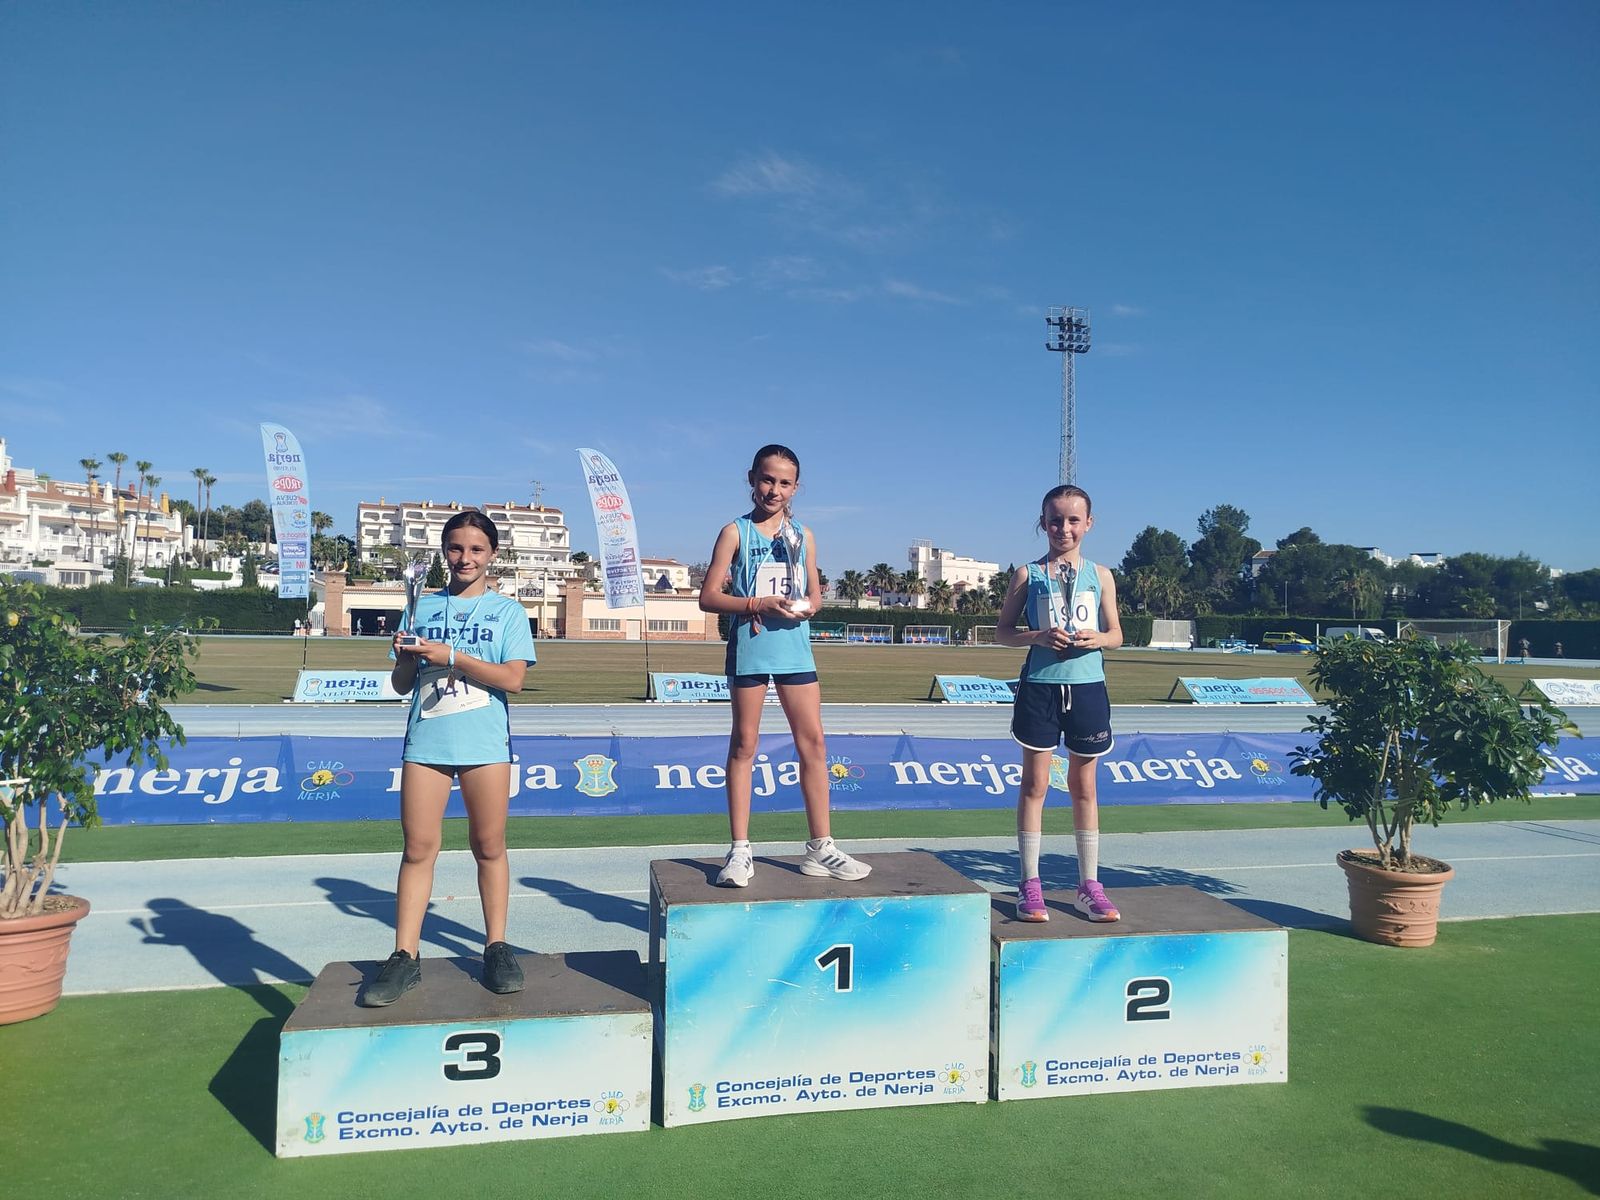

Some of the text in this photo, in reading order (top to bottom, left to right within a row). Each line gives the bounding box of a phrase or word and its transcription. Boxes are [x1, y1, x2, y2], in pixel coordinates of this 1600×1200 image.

[428, 623, 494, 644] nerja
[324, 677, 379, 690] nerja
[681, 680, 730, 692] nerja
[959, 682, 1006, 694] nerja
[1202, 683, 1245, 695] nerja
[306, 760, 345, 771] CMD
[653, 754, 801, 797] neja
[1104, 750, 1243, 788] nerja
[93, 757, 283, 805] nerja
[297, 790, 341, 801] NERJA
[817, 945, 851, 991] 1
[1125, 978, 1171, 1022] 2
[443, 1031, 502, 1081] 3
[1045, 1051, 1241, 1071] Concejalía de Deportes
[715, 1068, 936, 1094] Concejalía de Deportes
[1047, 1064, 1240, 1085] Excmo. Ayto. de Nerja
[718, 1082, 934, 1109] Excmo. Ayto. de Nerja
[336, 1097, 592, 1125] Concejalía de Deportes
[338, 1112, 589, 1141] Excmo. Ayto. de Nerja
